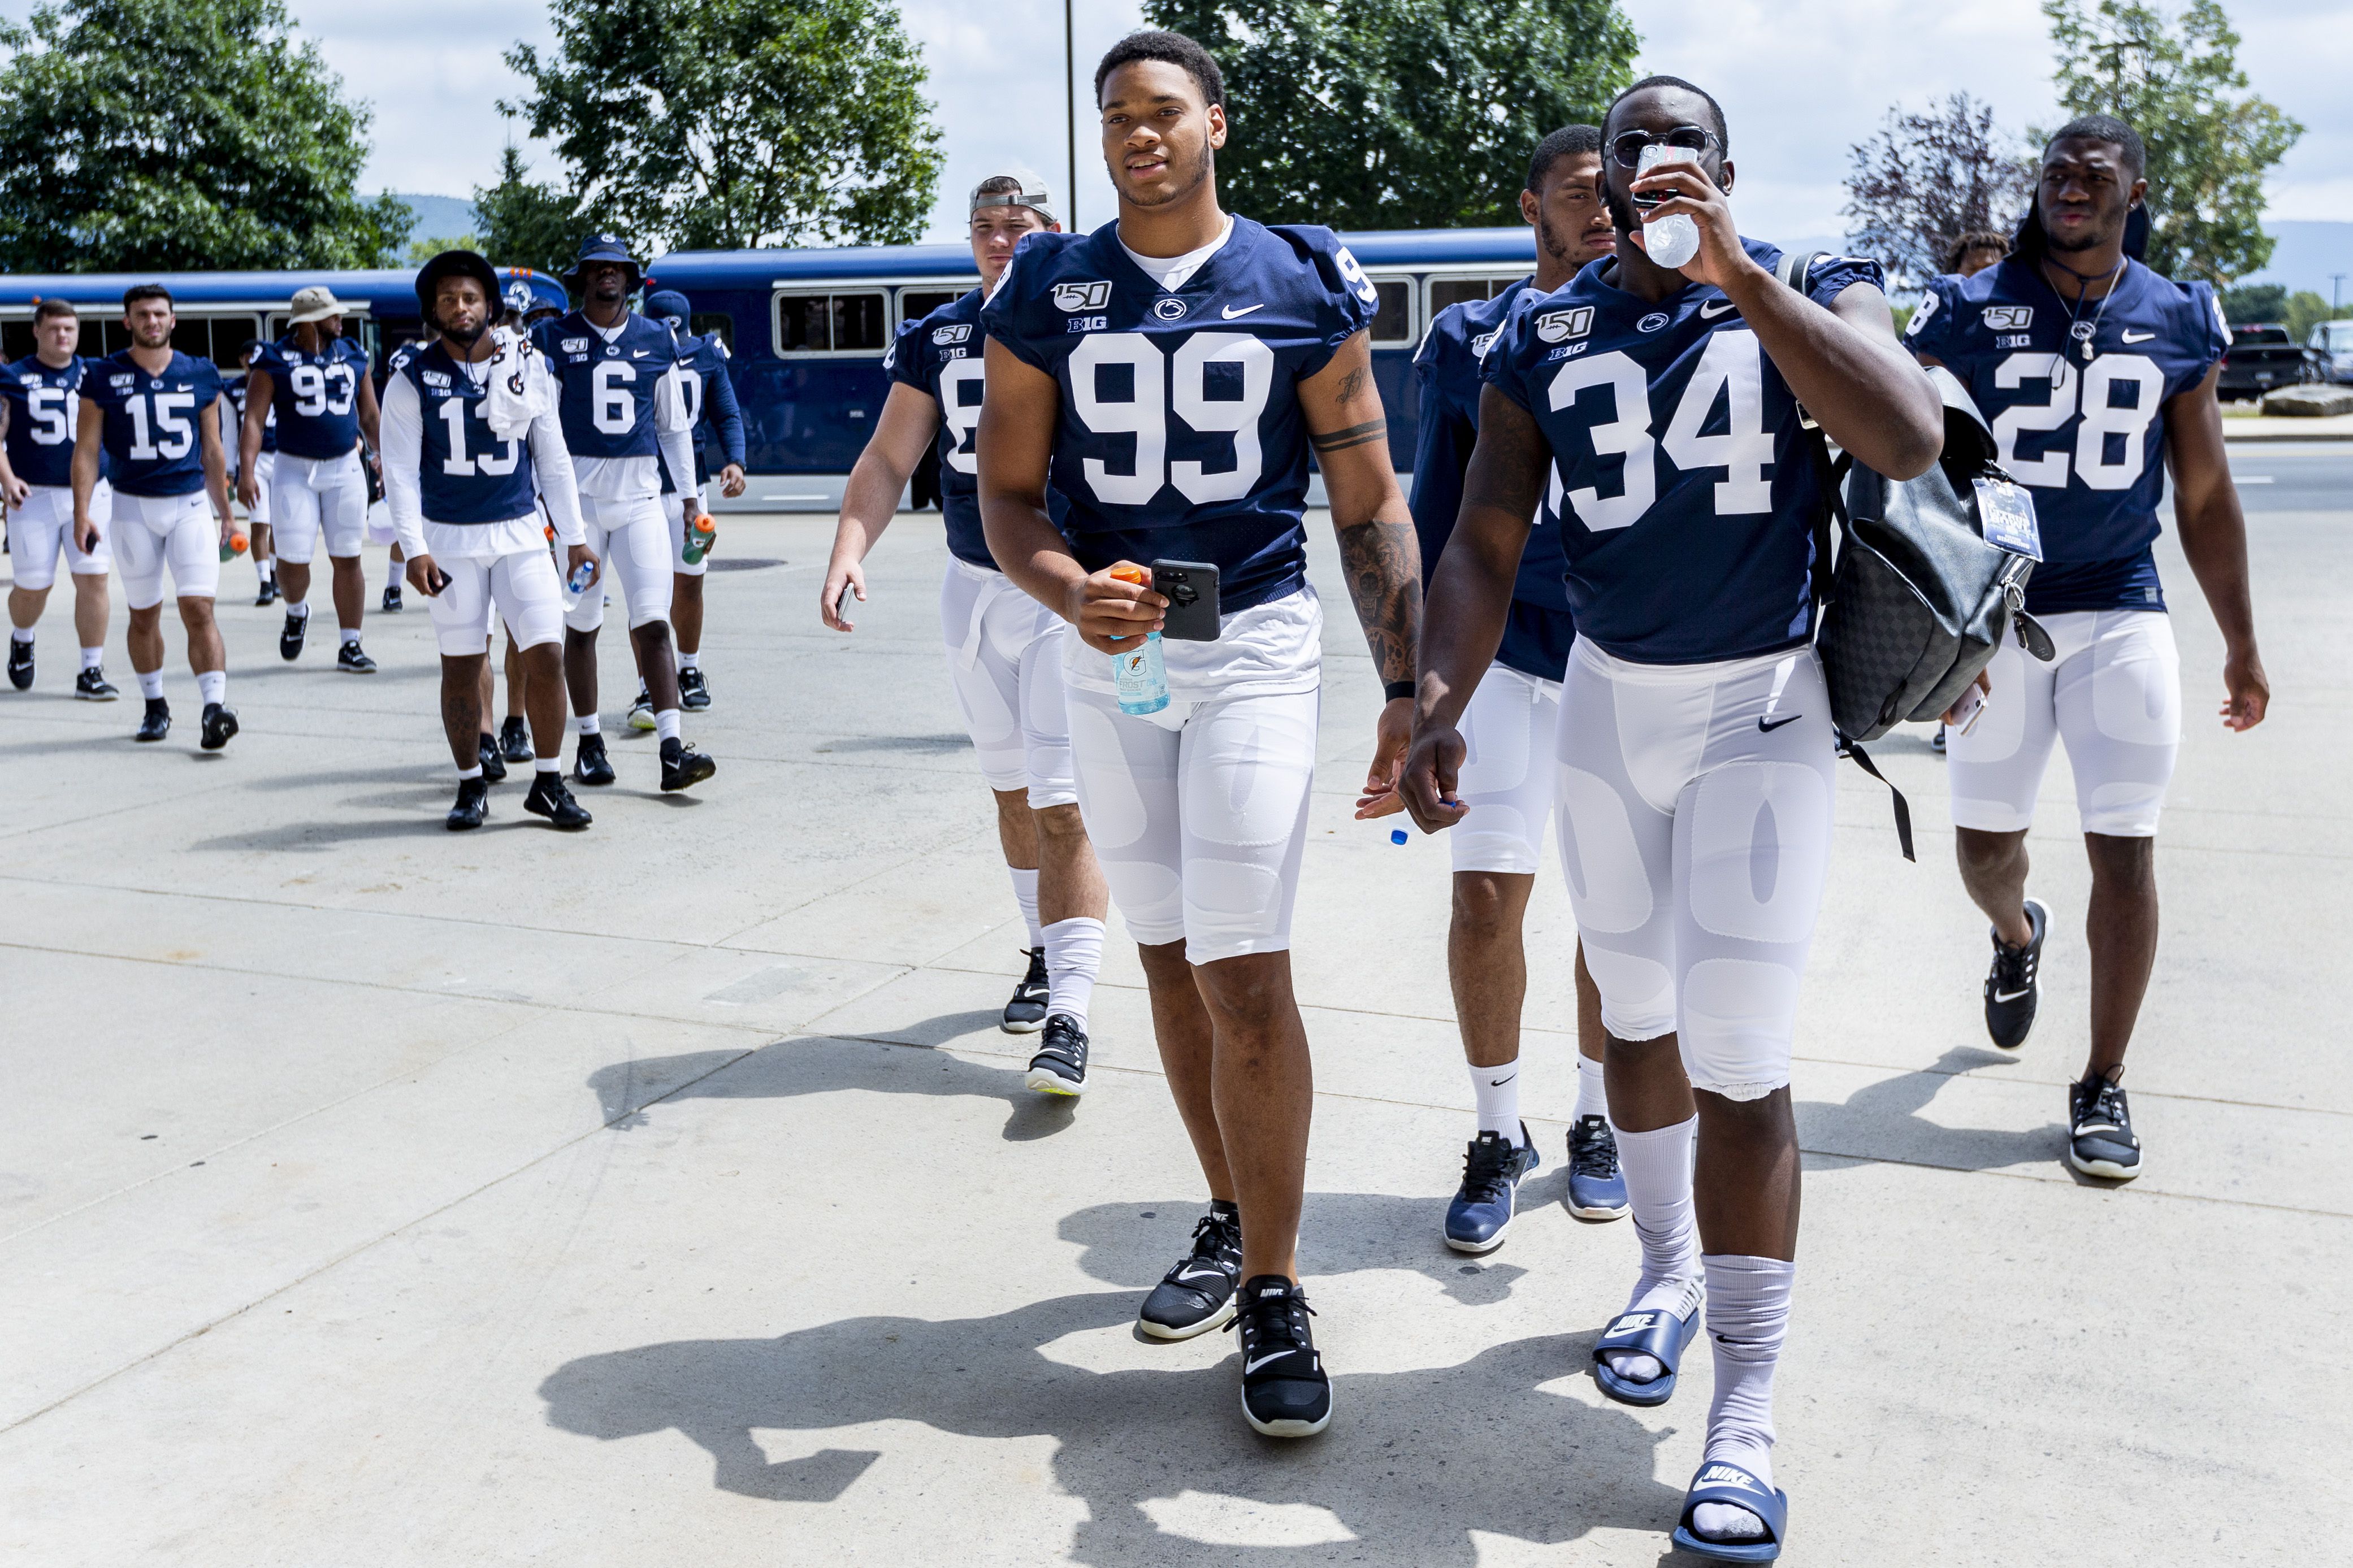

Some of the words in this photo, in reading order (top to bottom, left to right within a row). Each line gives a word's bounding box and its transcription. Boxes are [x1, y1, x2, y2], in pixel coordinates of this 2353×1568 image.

[1051, 281, 1112, 312] 150
[932, 324, 972, 345] 150
[1535, 306, 1594, 343] 150
[1981, 306, 2034, 330] 150
[291, 364, 356, 416] 93
[593, 360, 636, 434] 6
[125, 393, 195, 459] 15
[1069, 333, 1274, 505] 99
[1548, 330, 1775, 532] 34
[1992, 353, 2164, 490] 28
[1123, 649, 1146, 676] G
[1614, 1314, 1655, 1329] NIKE
[1704, 1466, 1755, 1486] NIKE
